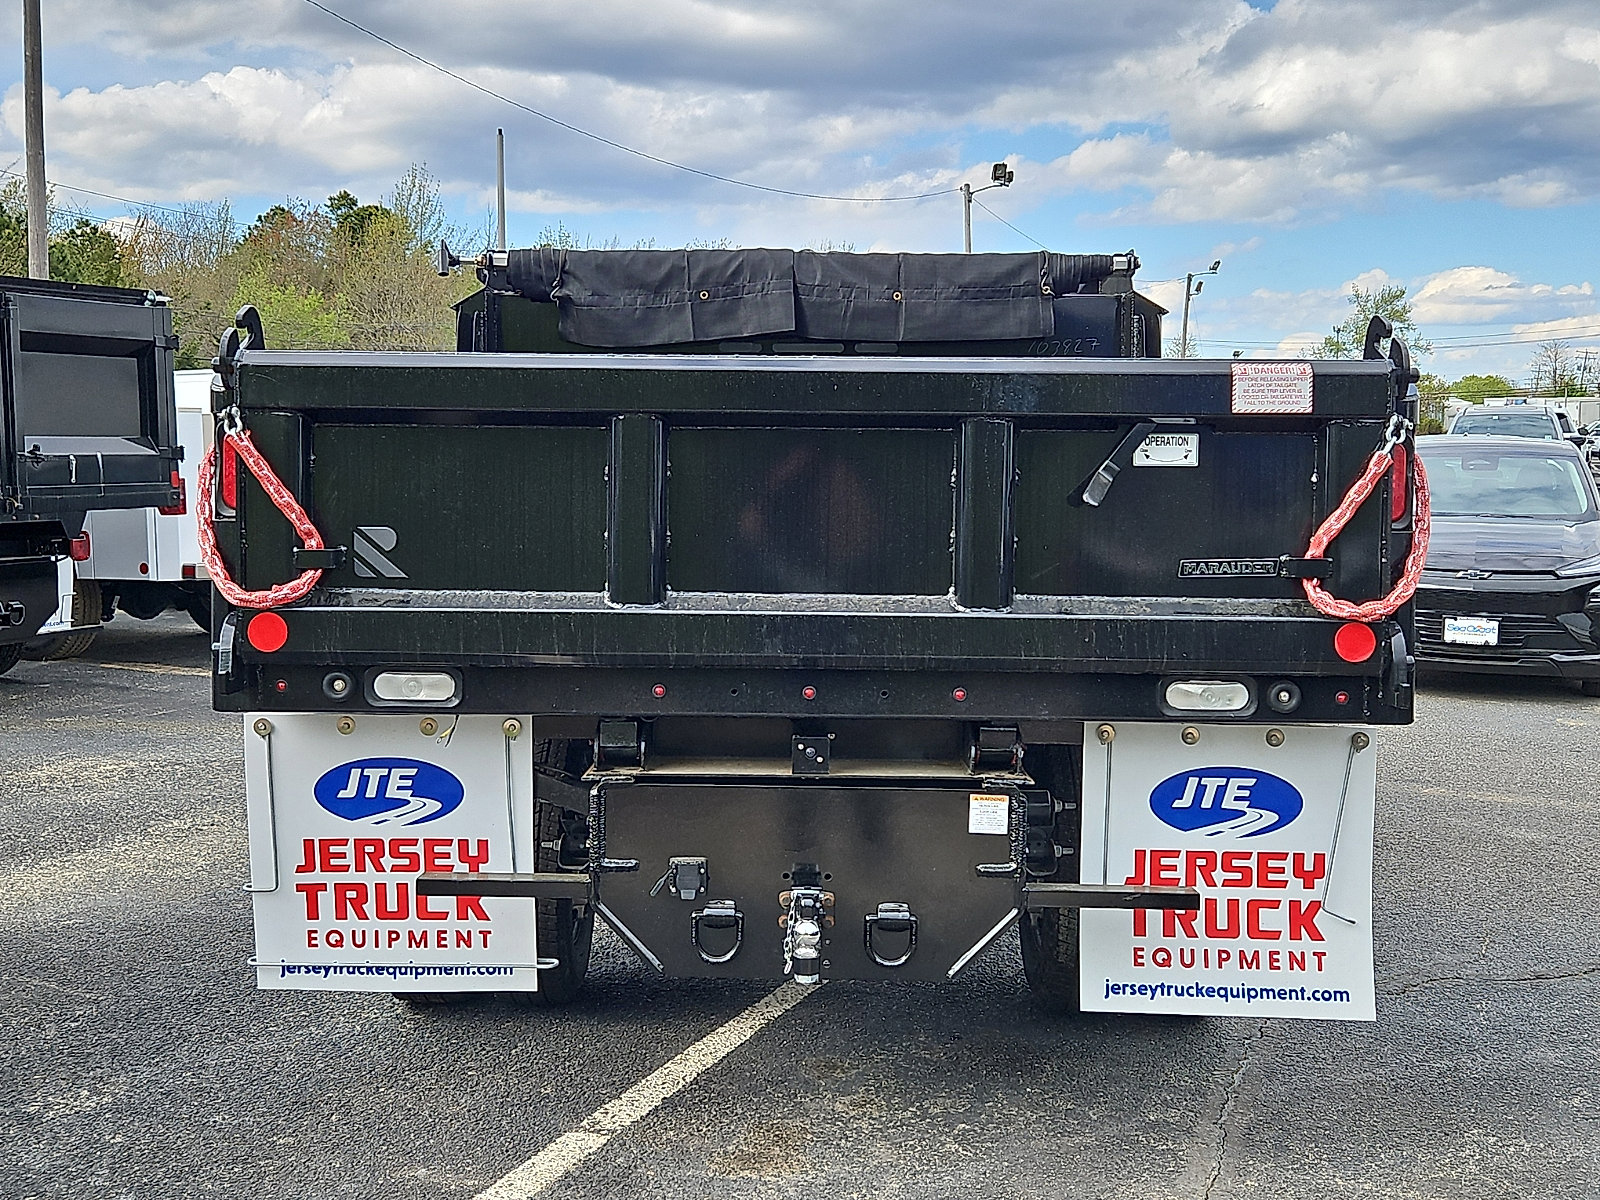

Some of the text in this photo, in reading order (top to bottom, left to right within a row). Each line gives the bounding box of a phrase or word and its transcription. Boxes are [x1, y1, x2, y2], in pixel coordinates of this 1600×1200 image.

[1144, 436, 1189, 446] OPERATION
[1183, 562, 1274, 574] MARAUDER
[336, 768, 418, 798] JTE
[1172, 777, 1257, 808] JTE
[295, 838, 489, 873] JERSEY
[1124, 849, 1326, 889] JERSEY
[295, 882, 491, 921] TRUCK
[307, 930, 492, 948] EQUIPMENT
[280, 959, 513, 979] jerseytruckequipment.com
[1133, 947, 1327, 971] EQUIPMENT
[1104, 978, 1350, 1003] jerseytruckequipment.com
